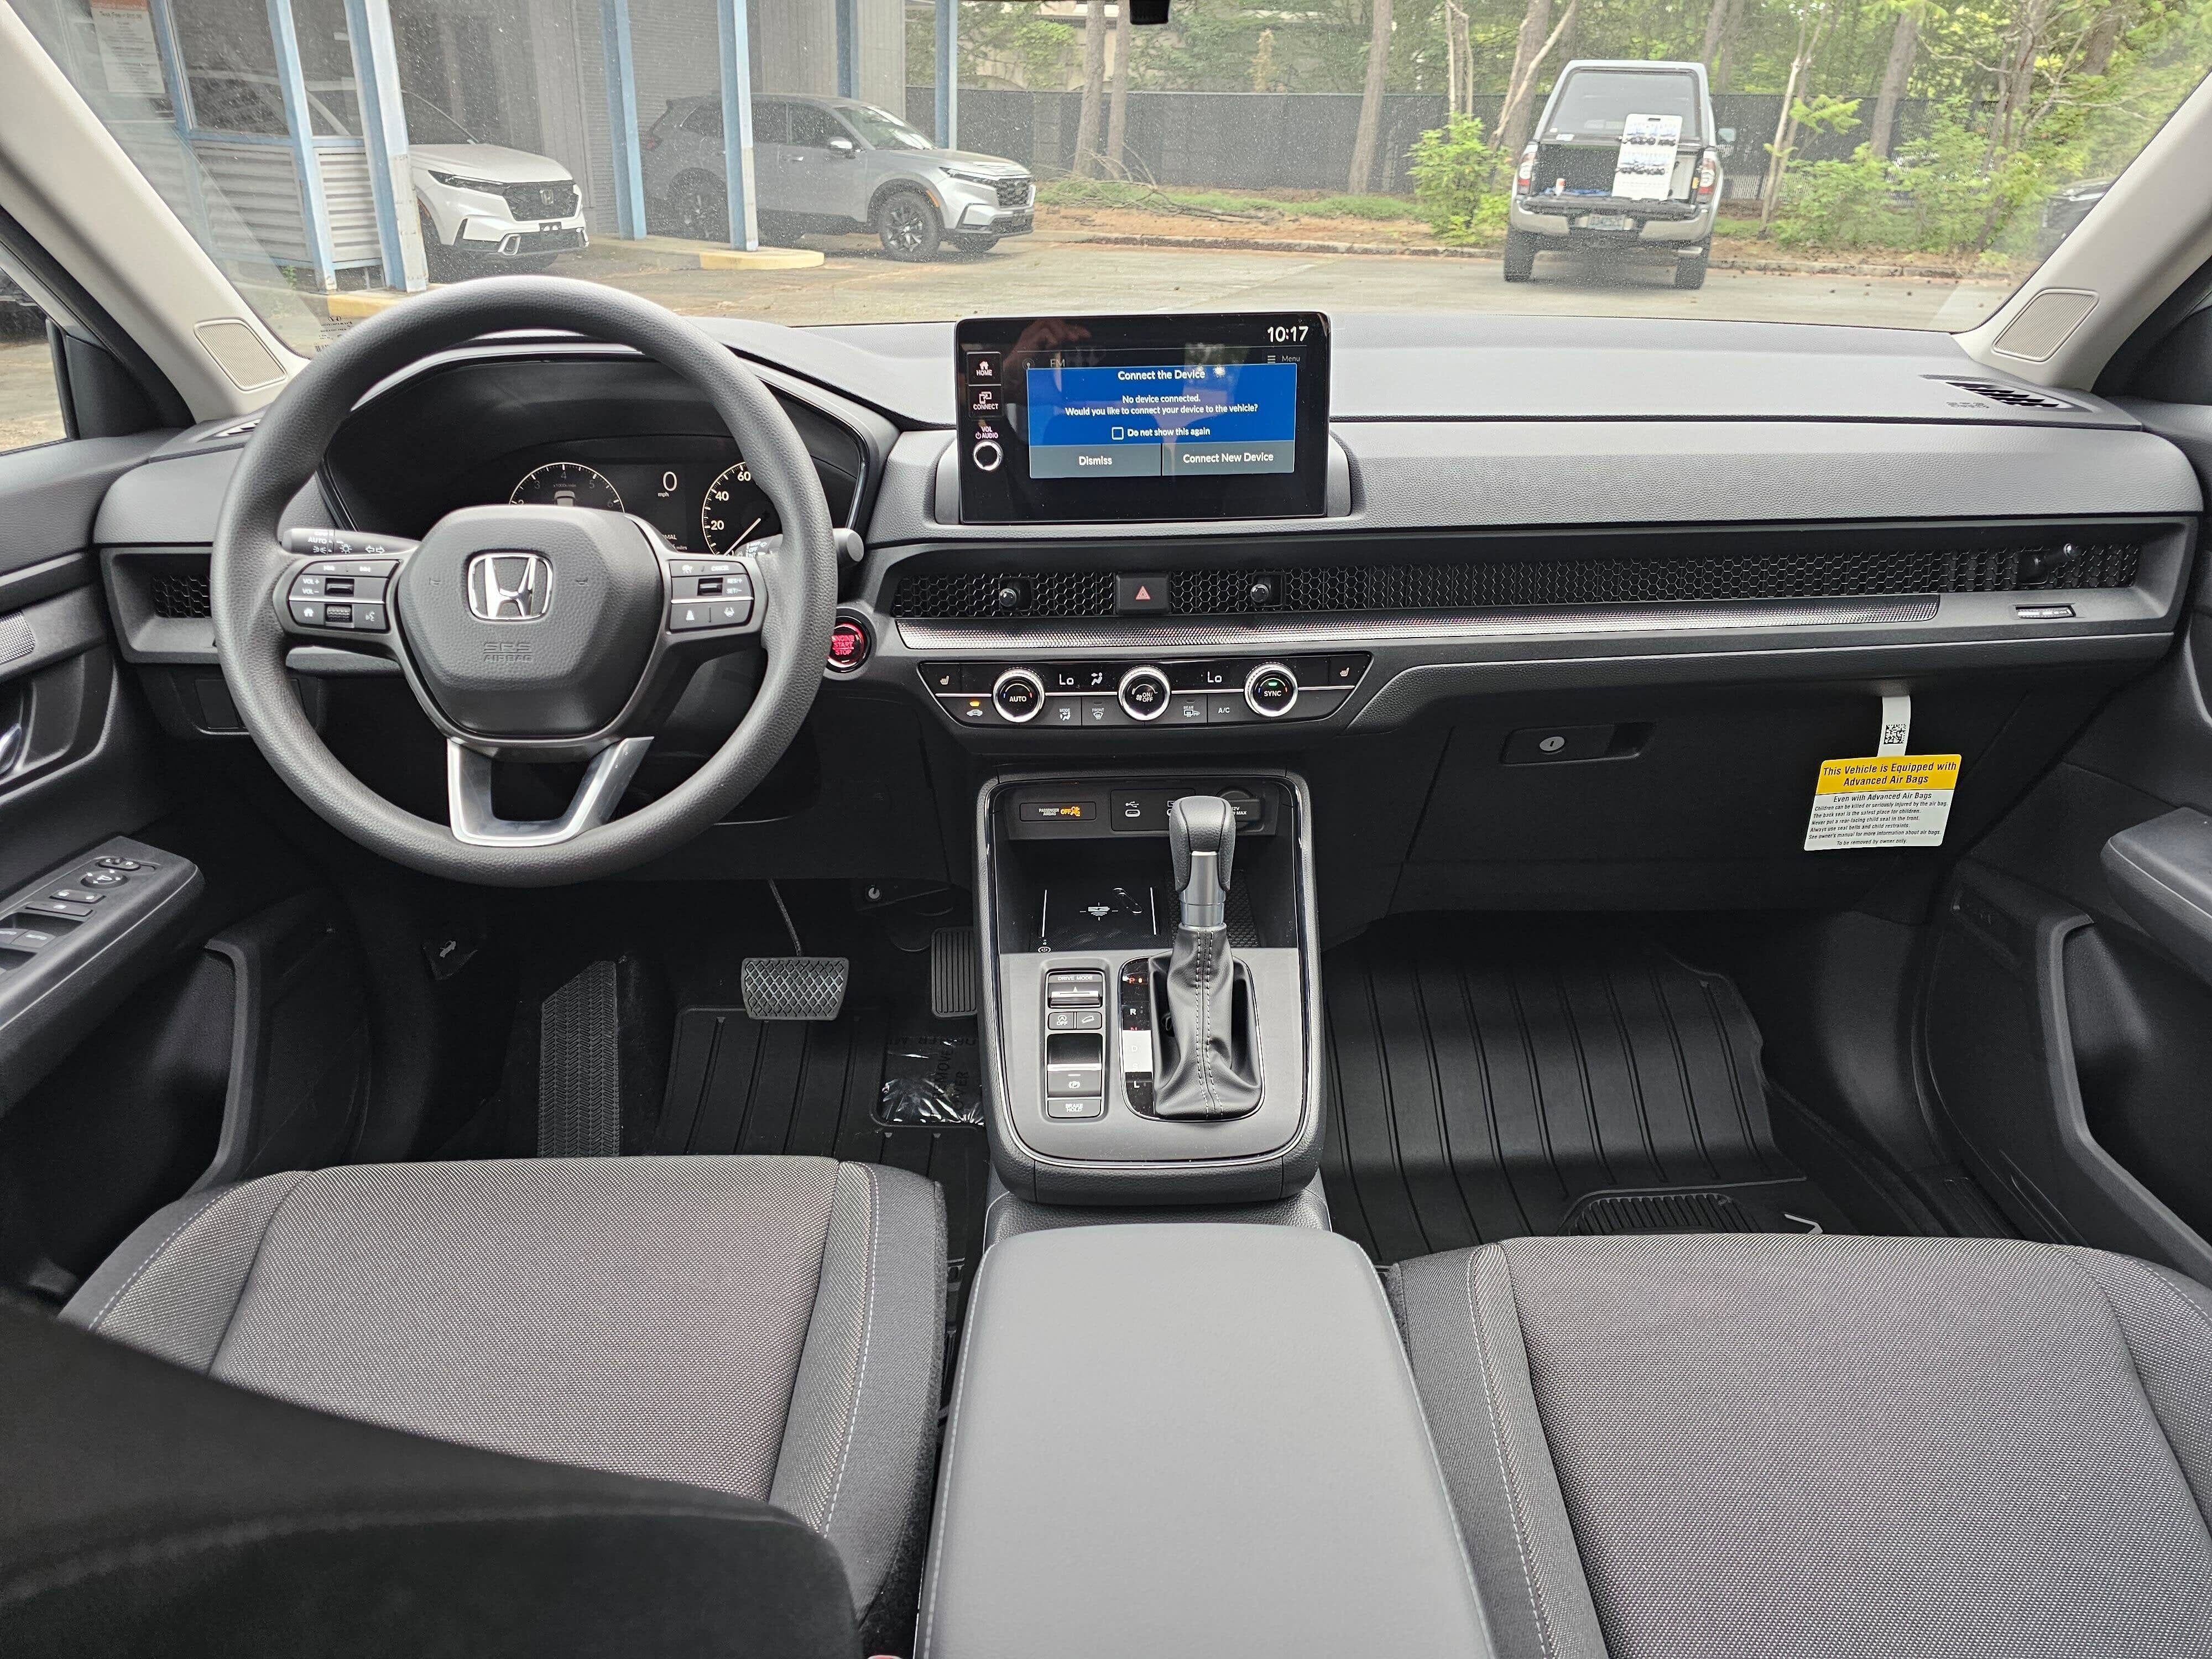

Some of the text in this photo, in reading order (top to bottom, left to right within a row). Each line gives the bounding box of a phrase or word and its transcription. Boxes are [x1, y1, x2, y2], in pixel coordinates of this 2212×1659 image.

[1267, 326, 1308, 342] 10:17
[1118, 369, 1206, 380] Connect the Device
[1160, 394, 1201, 403] connected.
[1065, 407, 1090, 415] Would
[1092, 408, 1105, 416] you
[1107, 406, 1120, 415] like
[1131, 406, 1160, 414] connect
[1161, 406, 1179, 415] your
[1181, 405, 1204, 413] device
[1215, 404, 1228, 413] the
[1229, 404, 1258, 413] vehicle?
[1176, 427, 1189, 436] this
[1190, 427, 1211, 436] again
[1078, 456, 1113, 466] Dismiss
[1183, 452, 1274, 463] Connect New Device
[663, 471, 677, 491] 0
[737, 471, 751, 481] 60
[534, 481, 540, 489] 3
[589, 480, 594, 488] 5
[715, 491, 729, 501] 40
[711, 520, 724, 530] 20
[1059, 674, 1074, 685] Lo
[1207, 671, 1222, 683] Lo
[1824, 767, 1841, 775] This
[1845, 765, 1877, 774] Vehicle
[1891, 763, 1934, 773] Equipped
[1937, 762, 1957, 770] with
[1843, 775, 1928, 786] Advanced Air Bags
